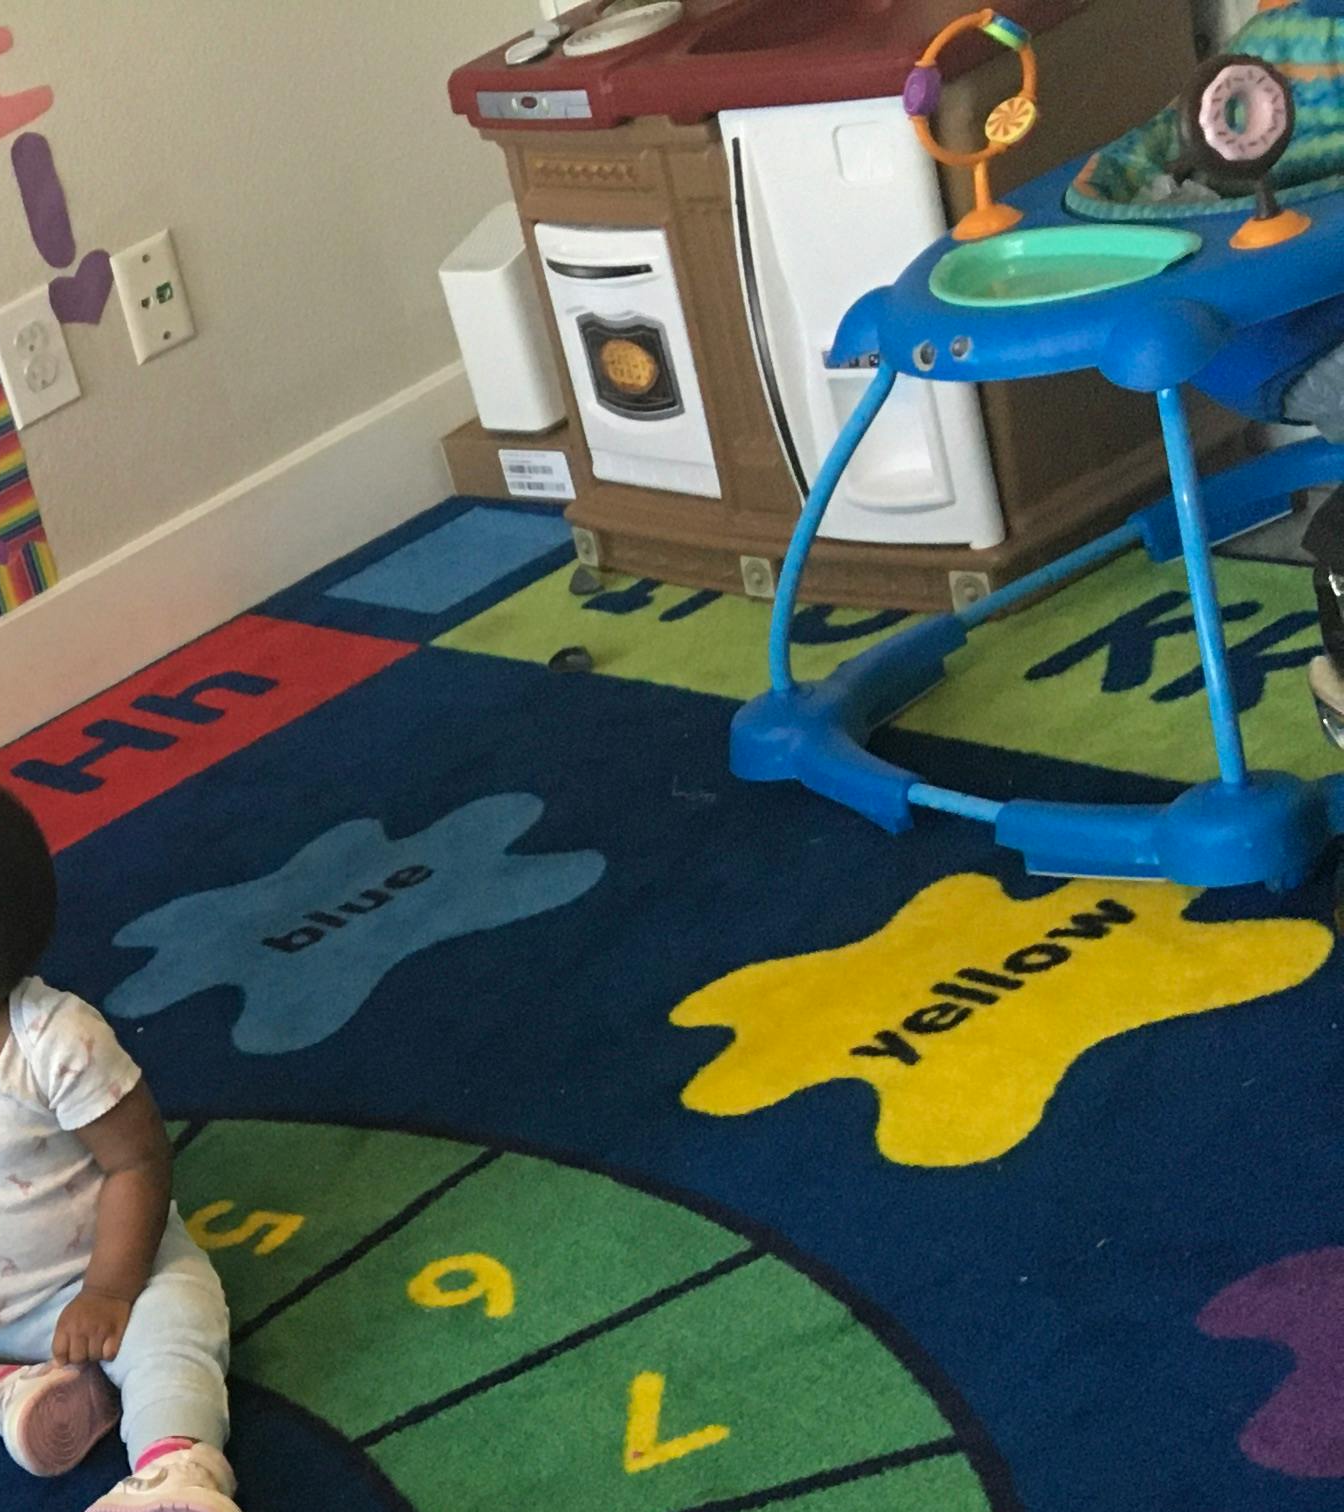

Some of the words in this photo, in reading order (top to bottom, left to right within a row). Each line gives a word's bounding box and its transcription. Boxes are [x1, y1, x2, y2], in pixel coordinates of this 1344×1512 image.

[11, 669, 281, 794] Hh
[261, 856, 435, 955] blue
[851, 899, 1136, 1066] yellow
[623, 1371, 731, 1475] 7
